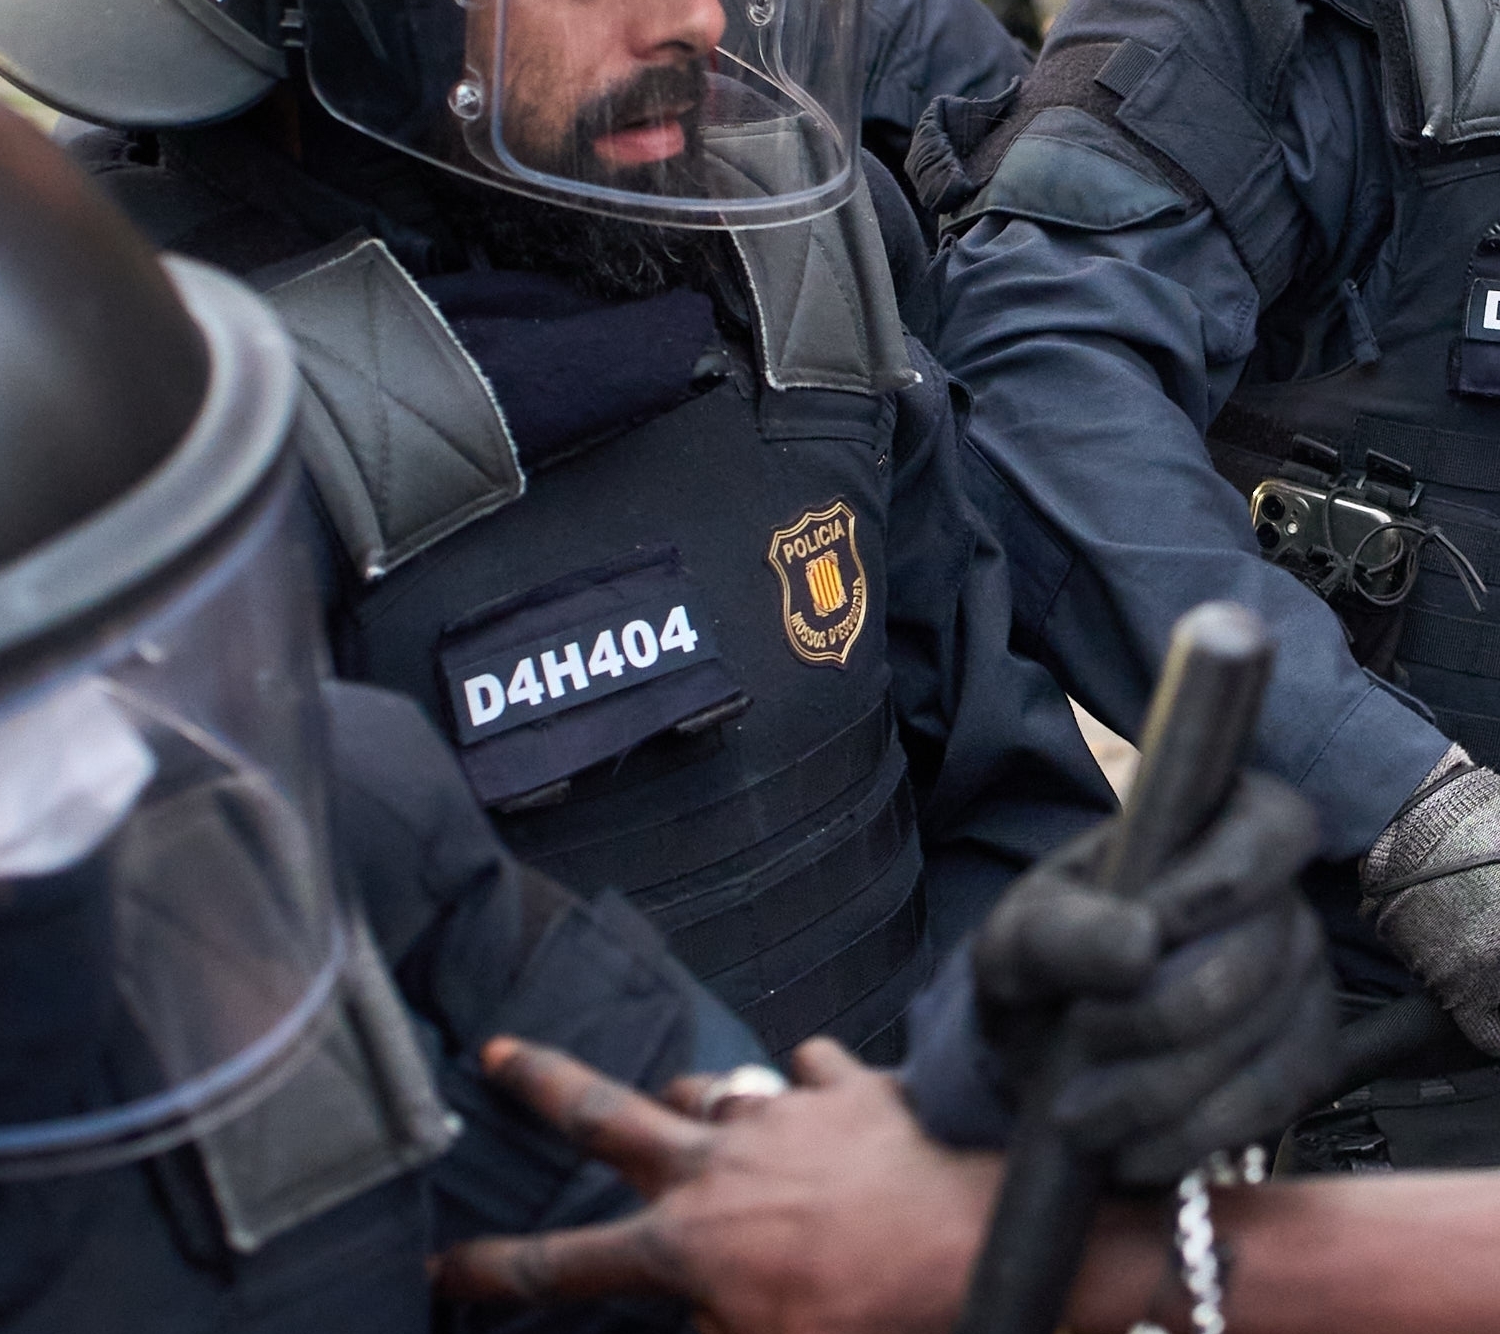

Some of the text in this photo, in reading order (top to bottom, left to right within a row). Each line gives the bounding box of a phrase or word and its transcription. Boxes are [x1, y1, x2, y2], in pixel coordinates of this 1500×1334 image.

[782, 518, 846, 564] POLICIA
[790, 611, 827, 649] MOSSOS
[464, 605, 699, 727] D4H404
